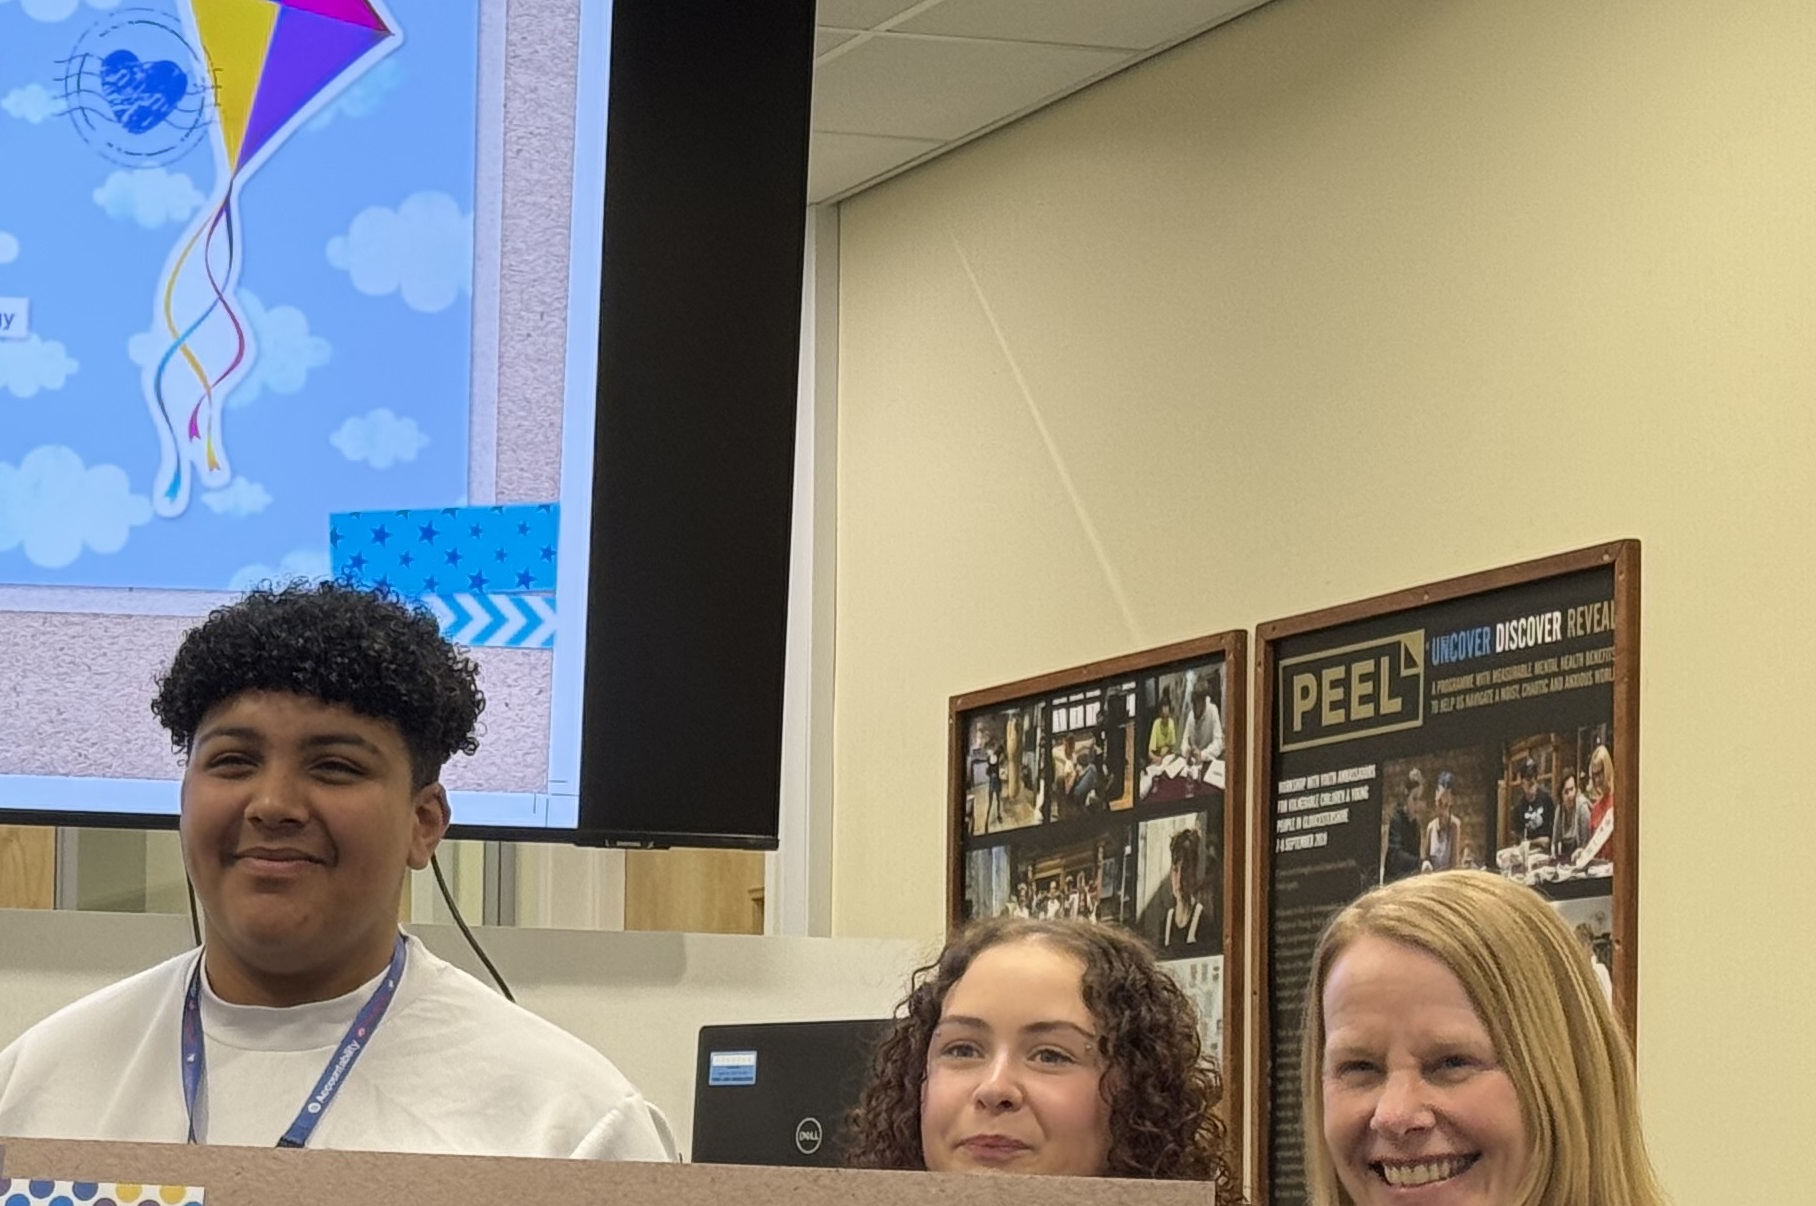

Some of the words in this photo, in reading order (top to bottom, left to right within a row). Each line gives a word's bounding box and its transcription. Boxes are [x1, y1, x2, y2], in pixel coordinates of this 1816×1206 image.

[1431, 627, 1491, 667] UNCOVER
[1495, 610, 1562, 653] DISCOVER
[1561, 652, 1584, 671] HEALTH
[1292, 655, 1403, 733] PEEL
[315, 1039, 361, 1104] Accountability
[798, 1130, 820, 1142] DELL
